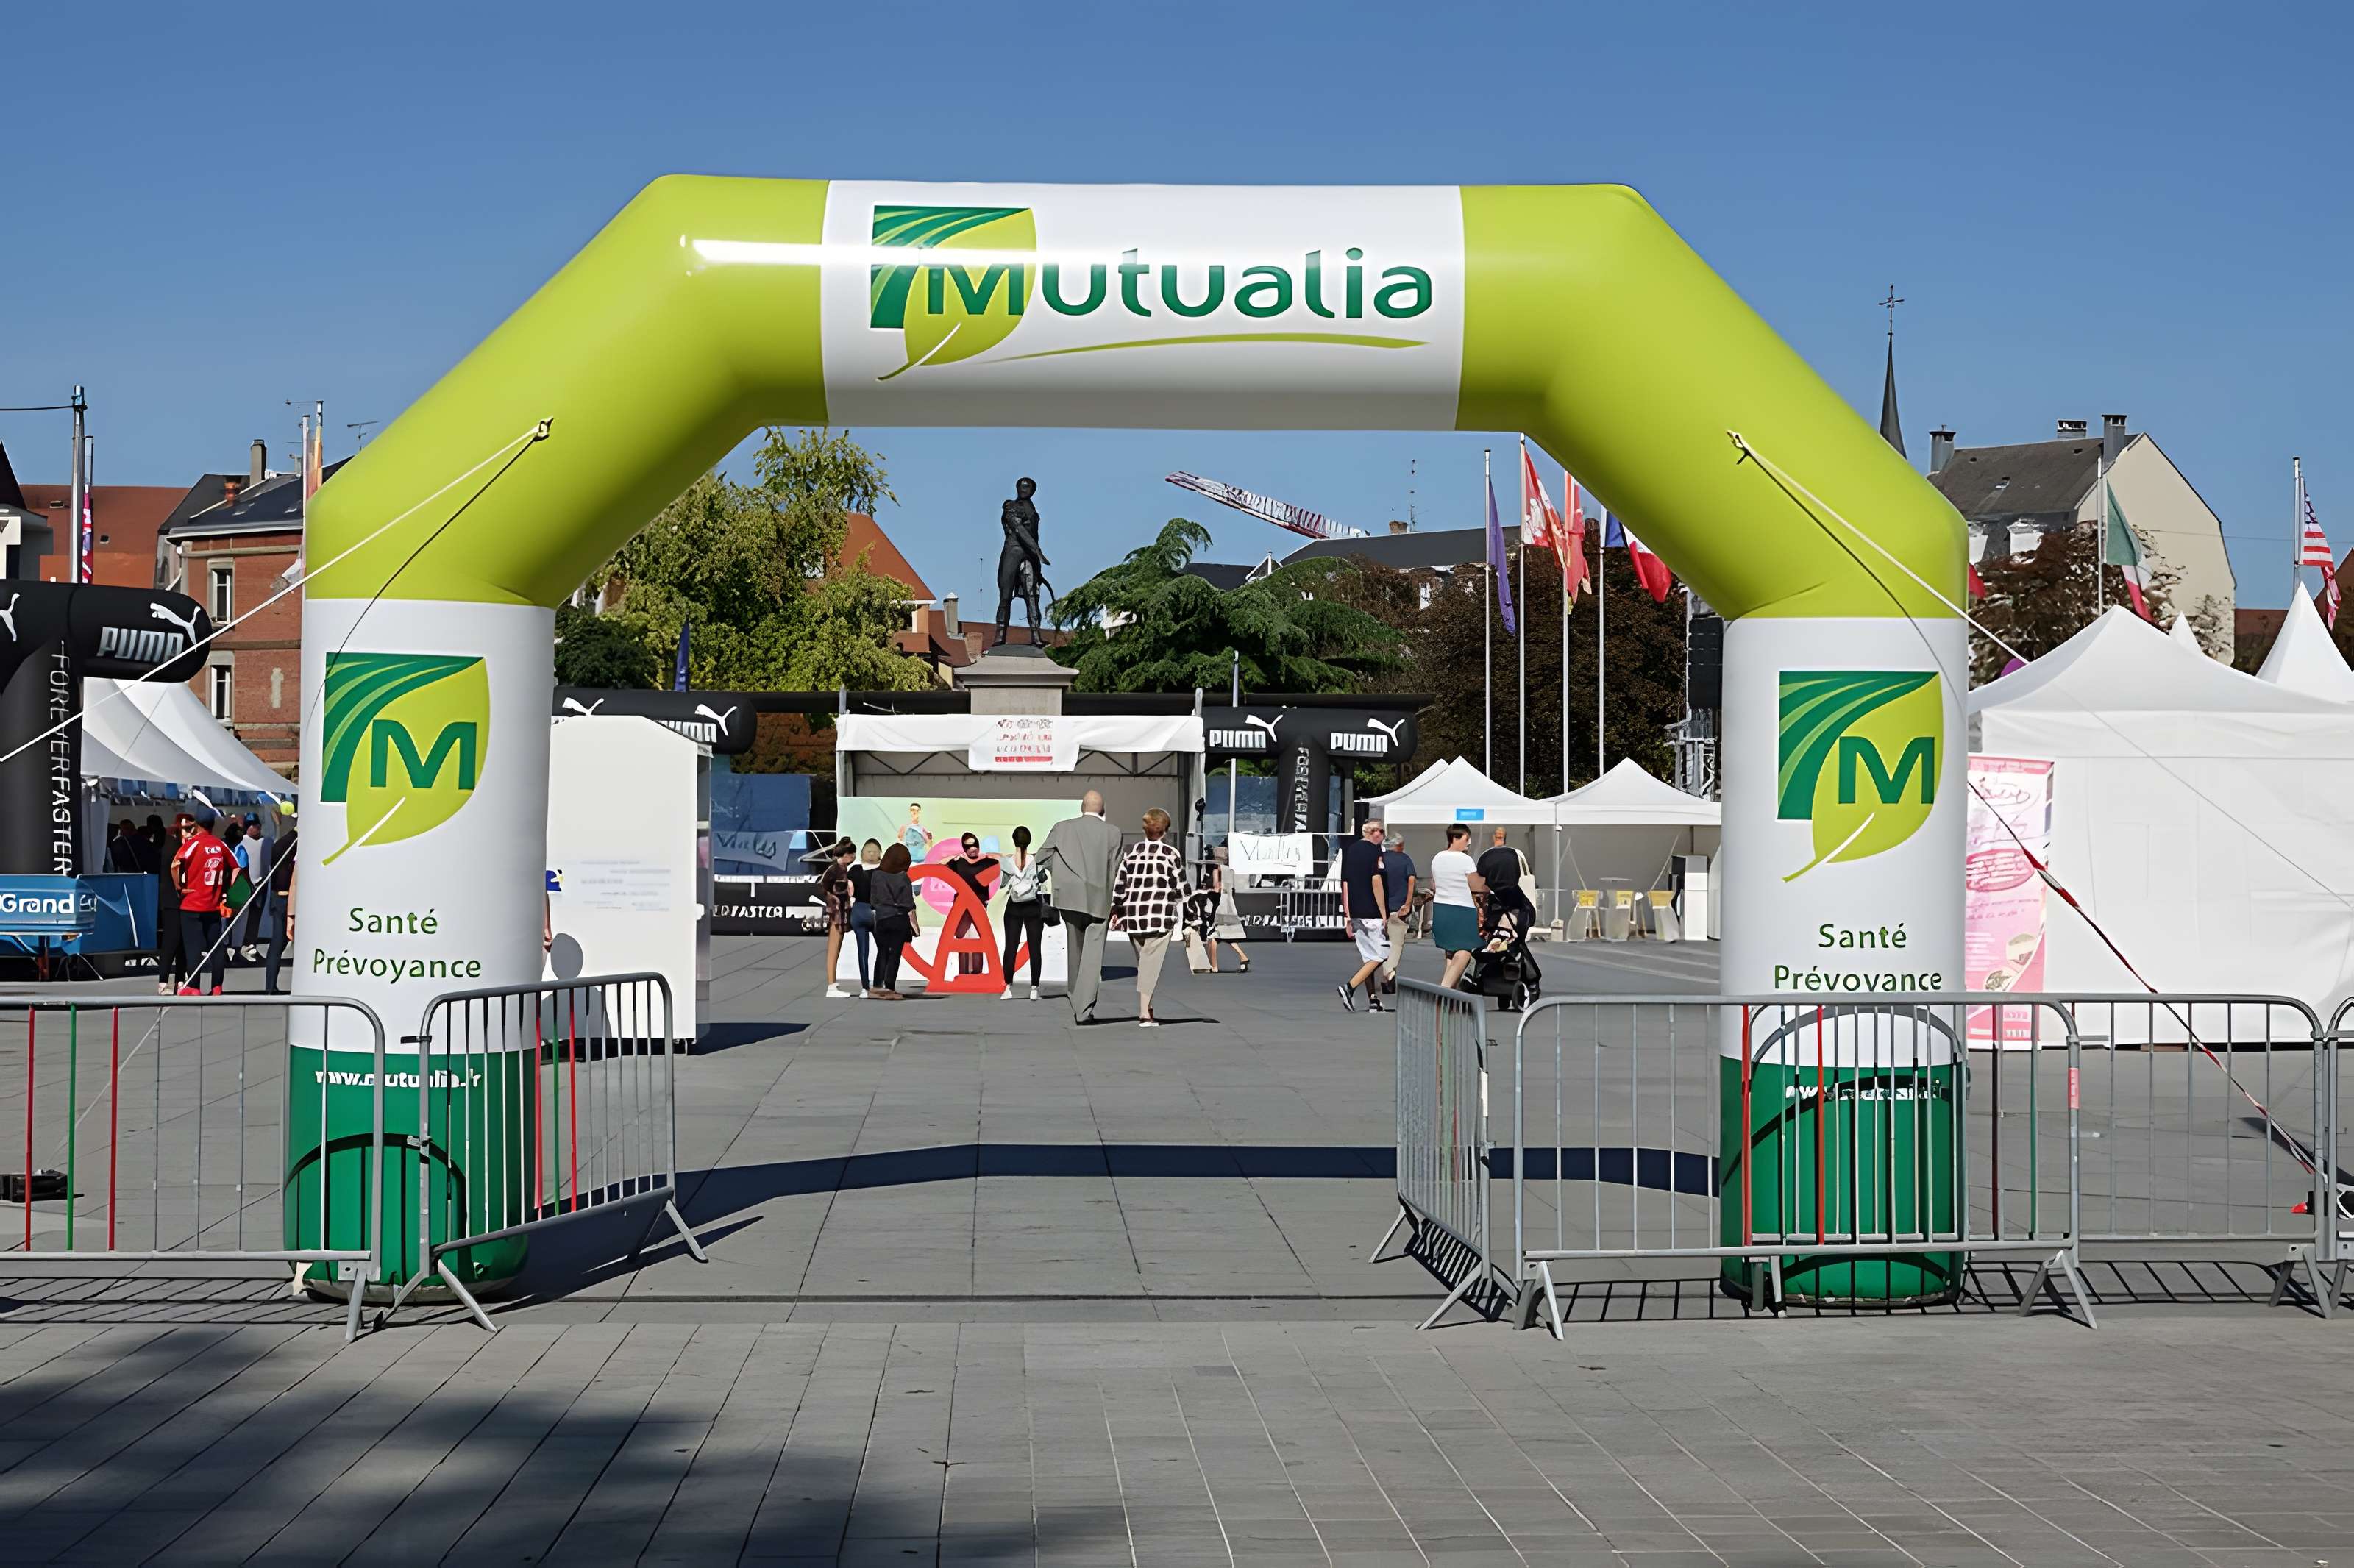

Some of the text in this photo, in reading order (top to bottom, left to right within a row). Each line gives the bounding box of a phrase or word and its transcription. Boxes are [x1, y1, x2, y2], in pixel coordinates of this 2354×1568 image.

[927, 246, 1432, 319] Mutualia
[96, 626, 185, 663] PUMA
[1209, 729, 1267, 748] PUMA
[1330, 732, 1388, 753] PUMA
[349, 908, 438, 935] Santé
[1818, 923, 1907, 949] Santé
[313, 948, 482, 985] Prévoyance
